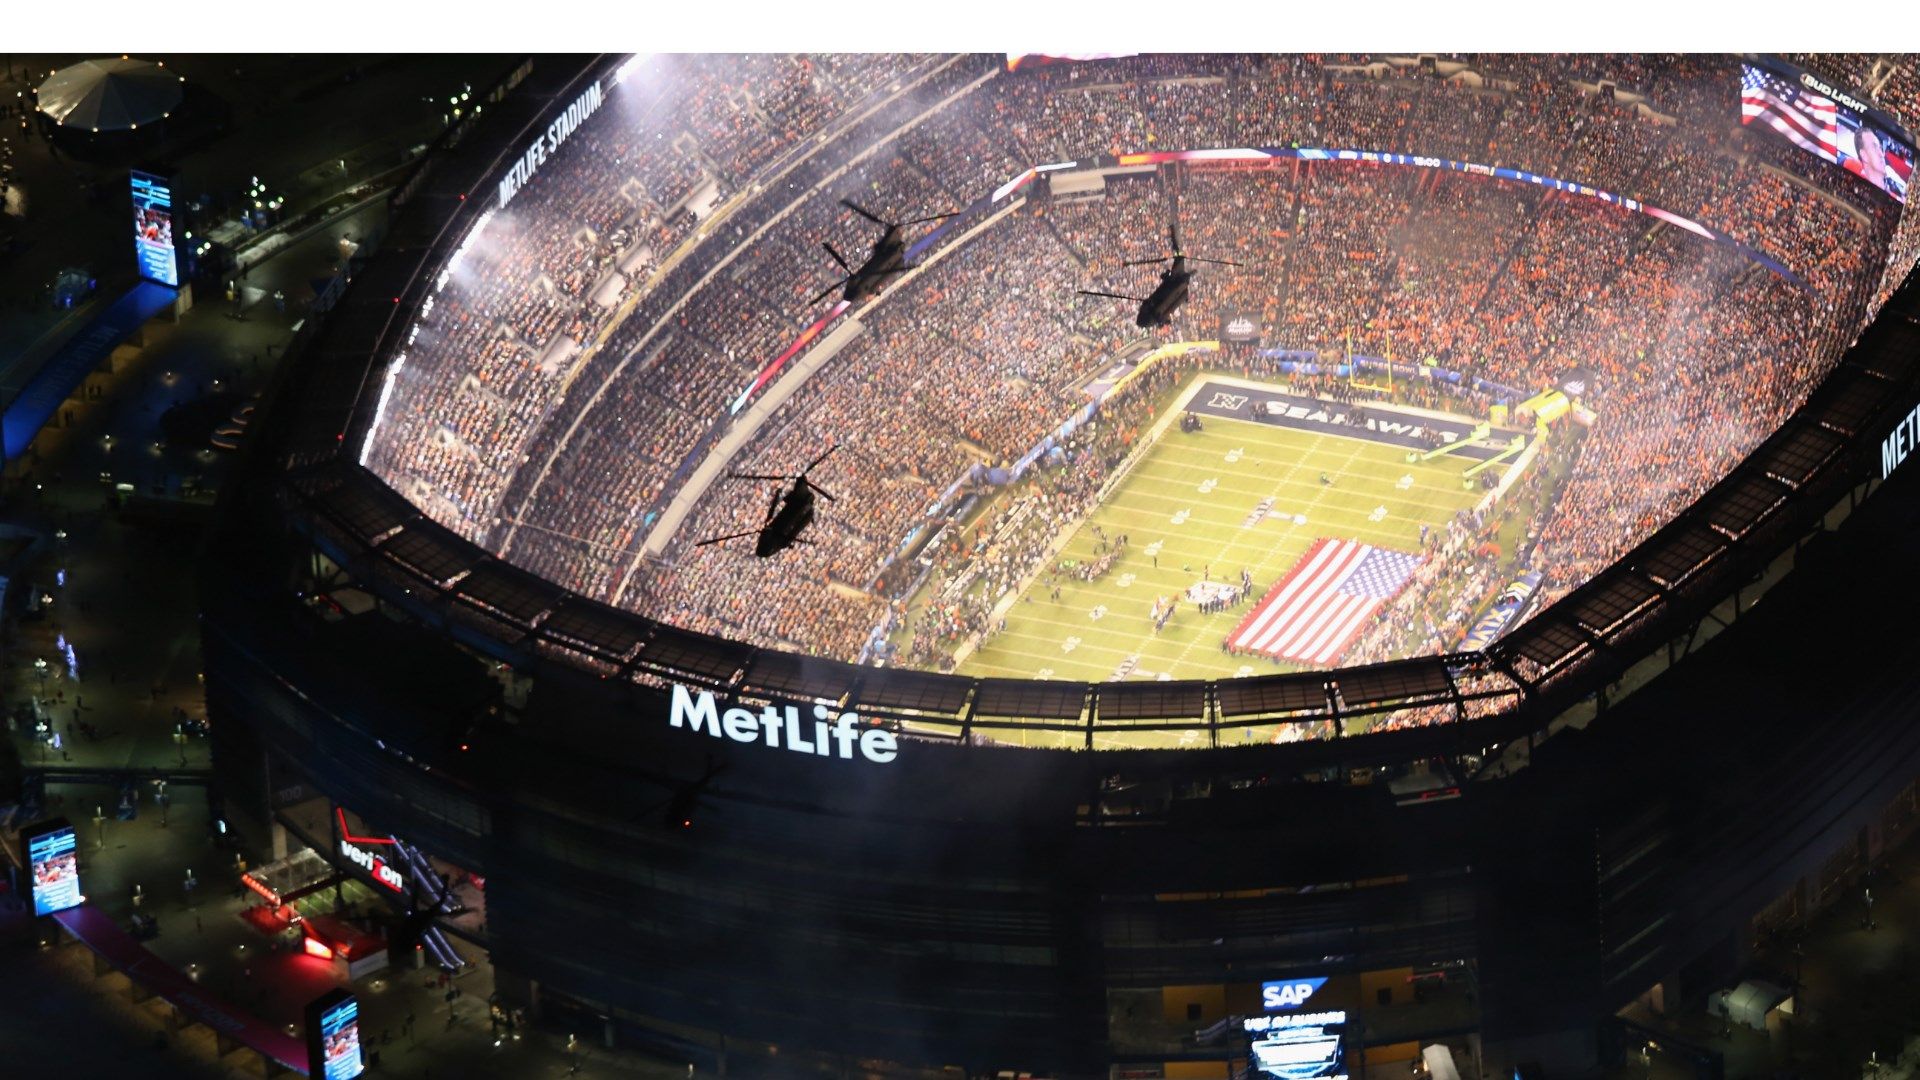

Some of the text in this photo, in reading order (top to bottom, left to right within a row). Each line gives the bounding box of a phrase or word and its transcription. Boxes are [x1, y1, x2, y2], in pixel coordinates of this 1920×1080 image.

[1804, 74, 1868, 114] BUD LIGHT
[499, 80, 602, 208] METLIFE STADIUM
[669, 684, 898, 763] MetLife
[341, 838, 403, 893] verizon
[1262, 983, 1313, 1008] SAP
